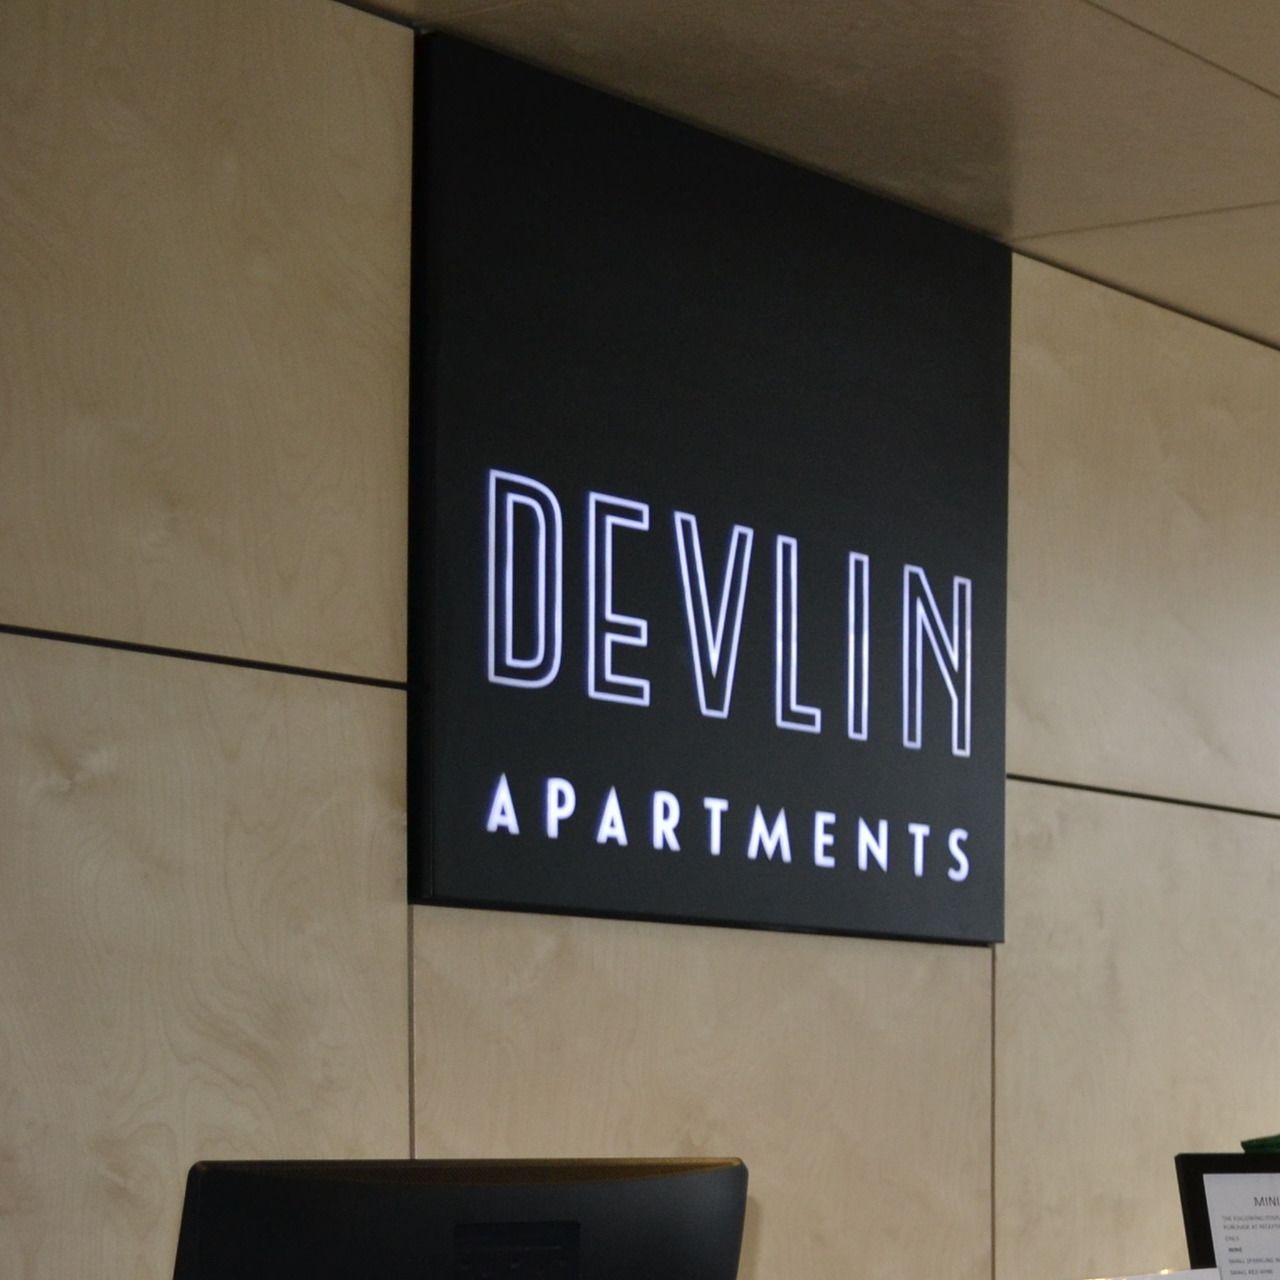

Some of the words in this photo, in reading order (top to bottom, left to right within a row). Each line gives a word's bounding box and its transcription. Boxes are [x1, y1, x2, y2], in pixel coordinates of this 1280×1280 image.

[488, 469, 972, 758] DEVLIN
[486, 773, 970, 882] APARTMENTS
[1253, 1196, 1280, 1207] MINI
